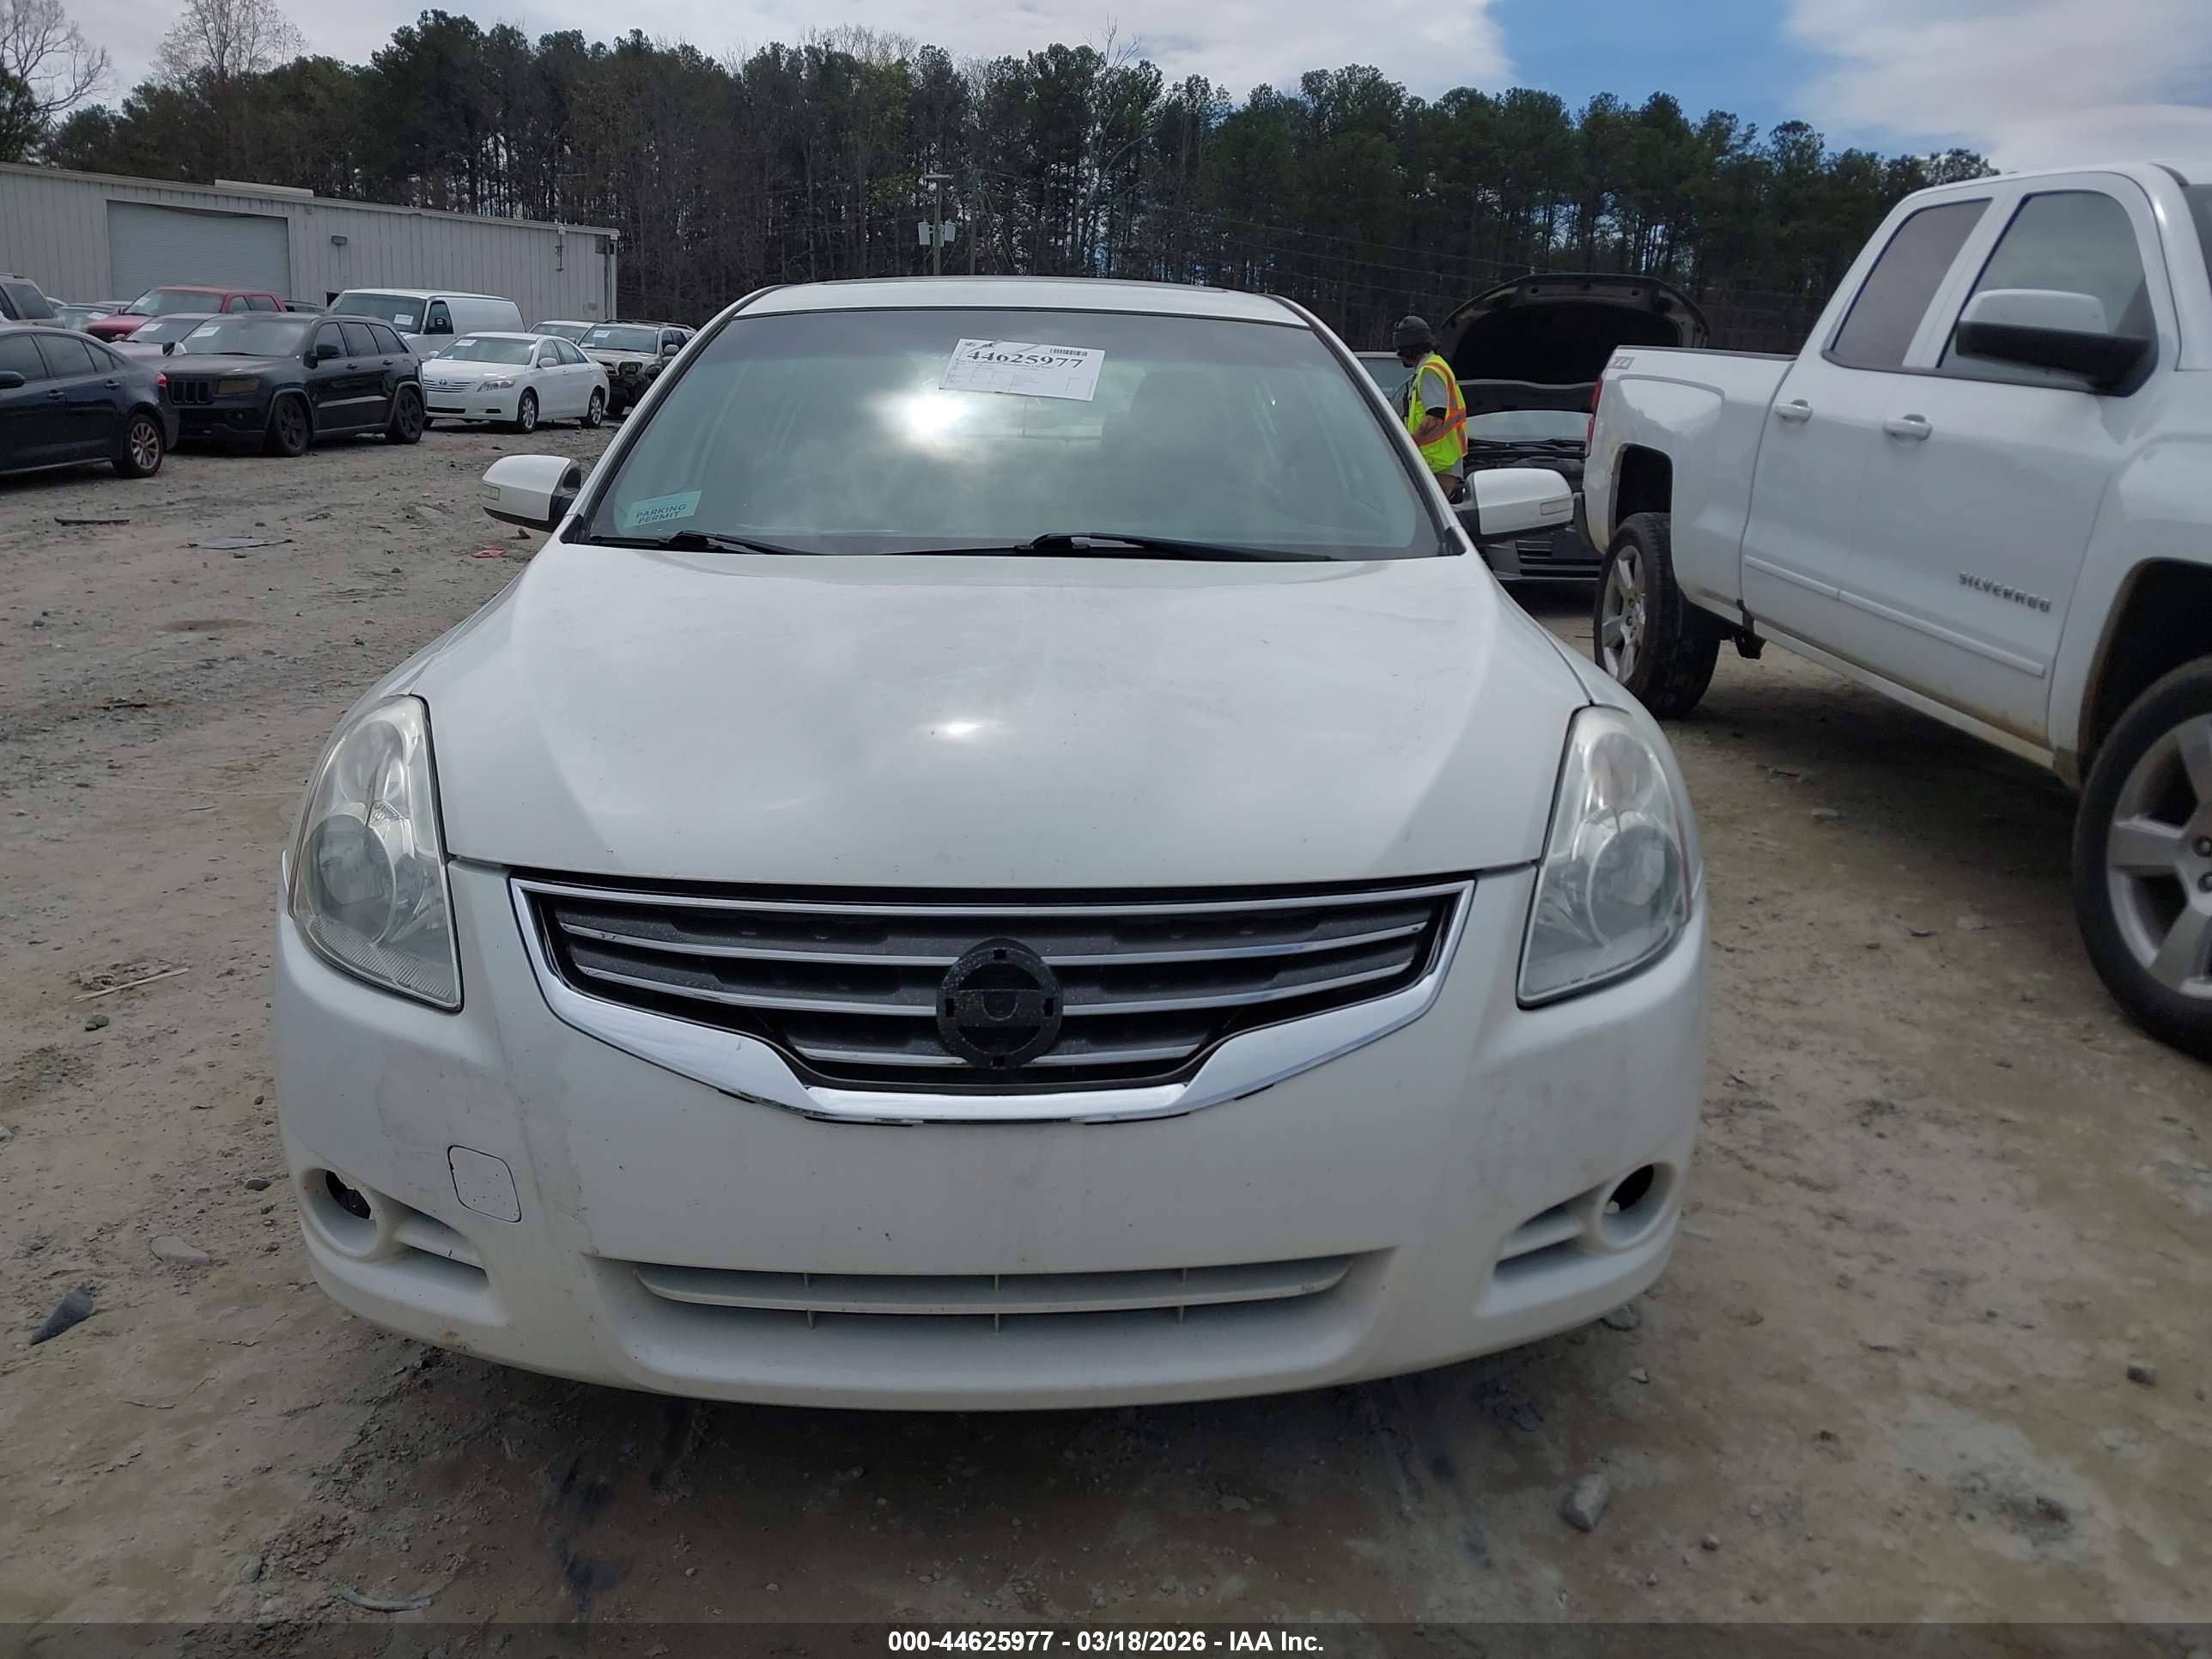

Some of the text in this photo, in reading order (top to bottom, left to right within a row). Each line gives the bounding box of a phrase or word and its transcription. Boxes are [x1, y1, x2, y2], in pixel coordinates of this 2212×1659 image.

[967, 350, 1084, 368] 44625977
[635, 503, 688, 519] PARKING
[638, 510, 680, 524] PERMIT
